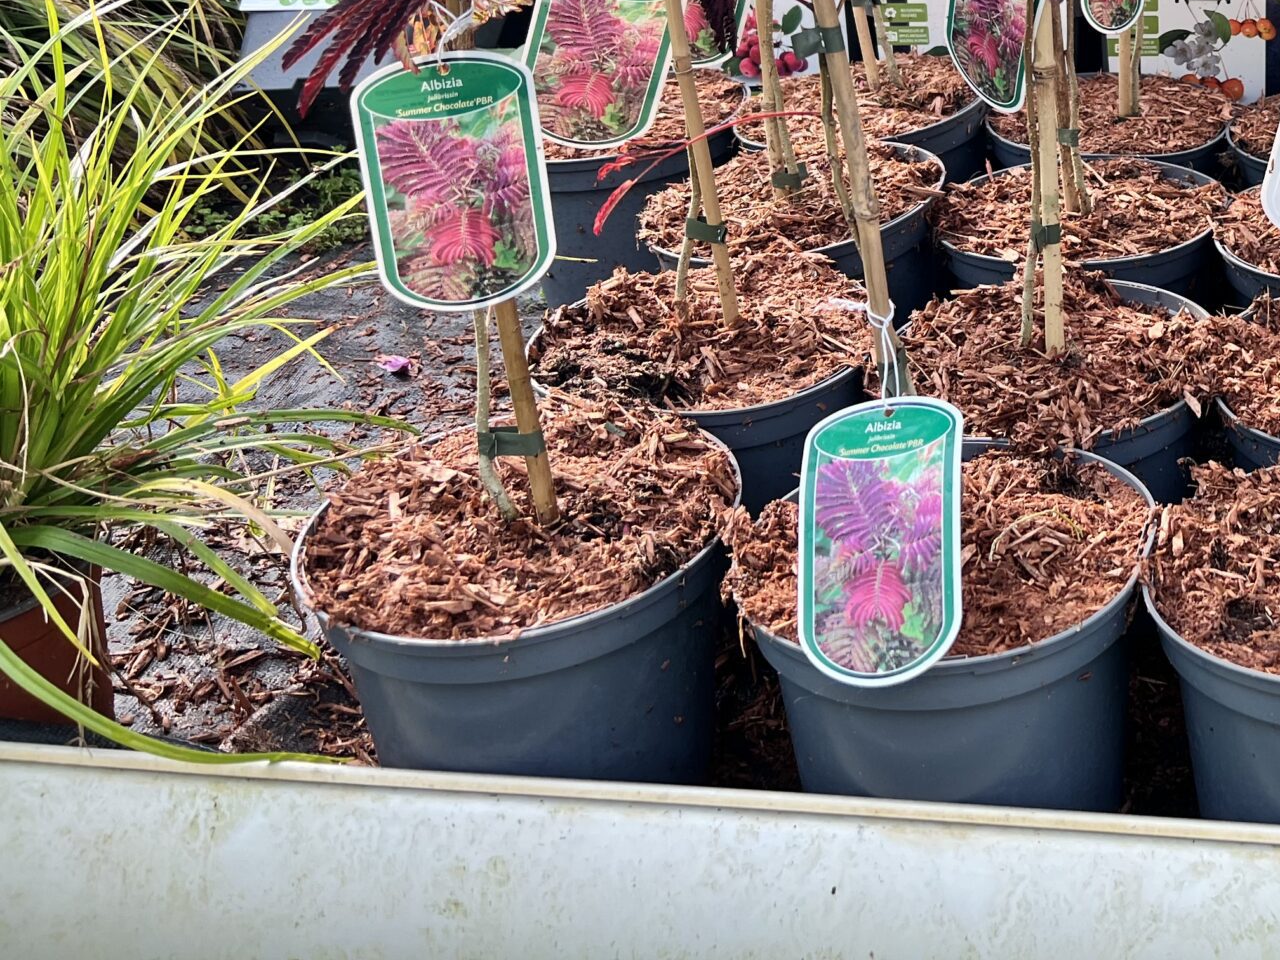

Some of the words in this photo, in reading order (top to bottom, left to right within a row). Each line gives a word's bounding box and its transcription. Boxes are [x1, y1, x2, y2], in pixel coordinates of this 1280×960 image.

[421, 77, 463, 92] Albizia
[396, 105, 432, 117] 'Summer
[865, 420, 902, 433] Albizia
[838, 446, 870, 457] 'Summer
